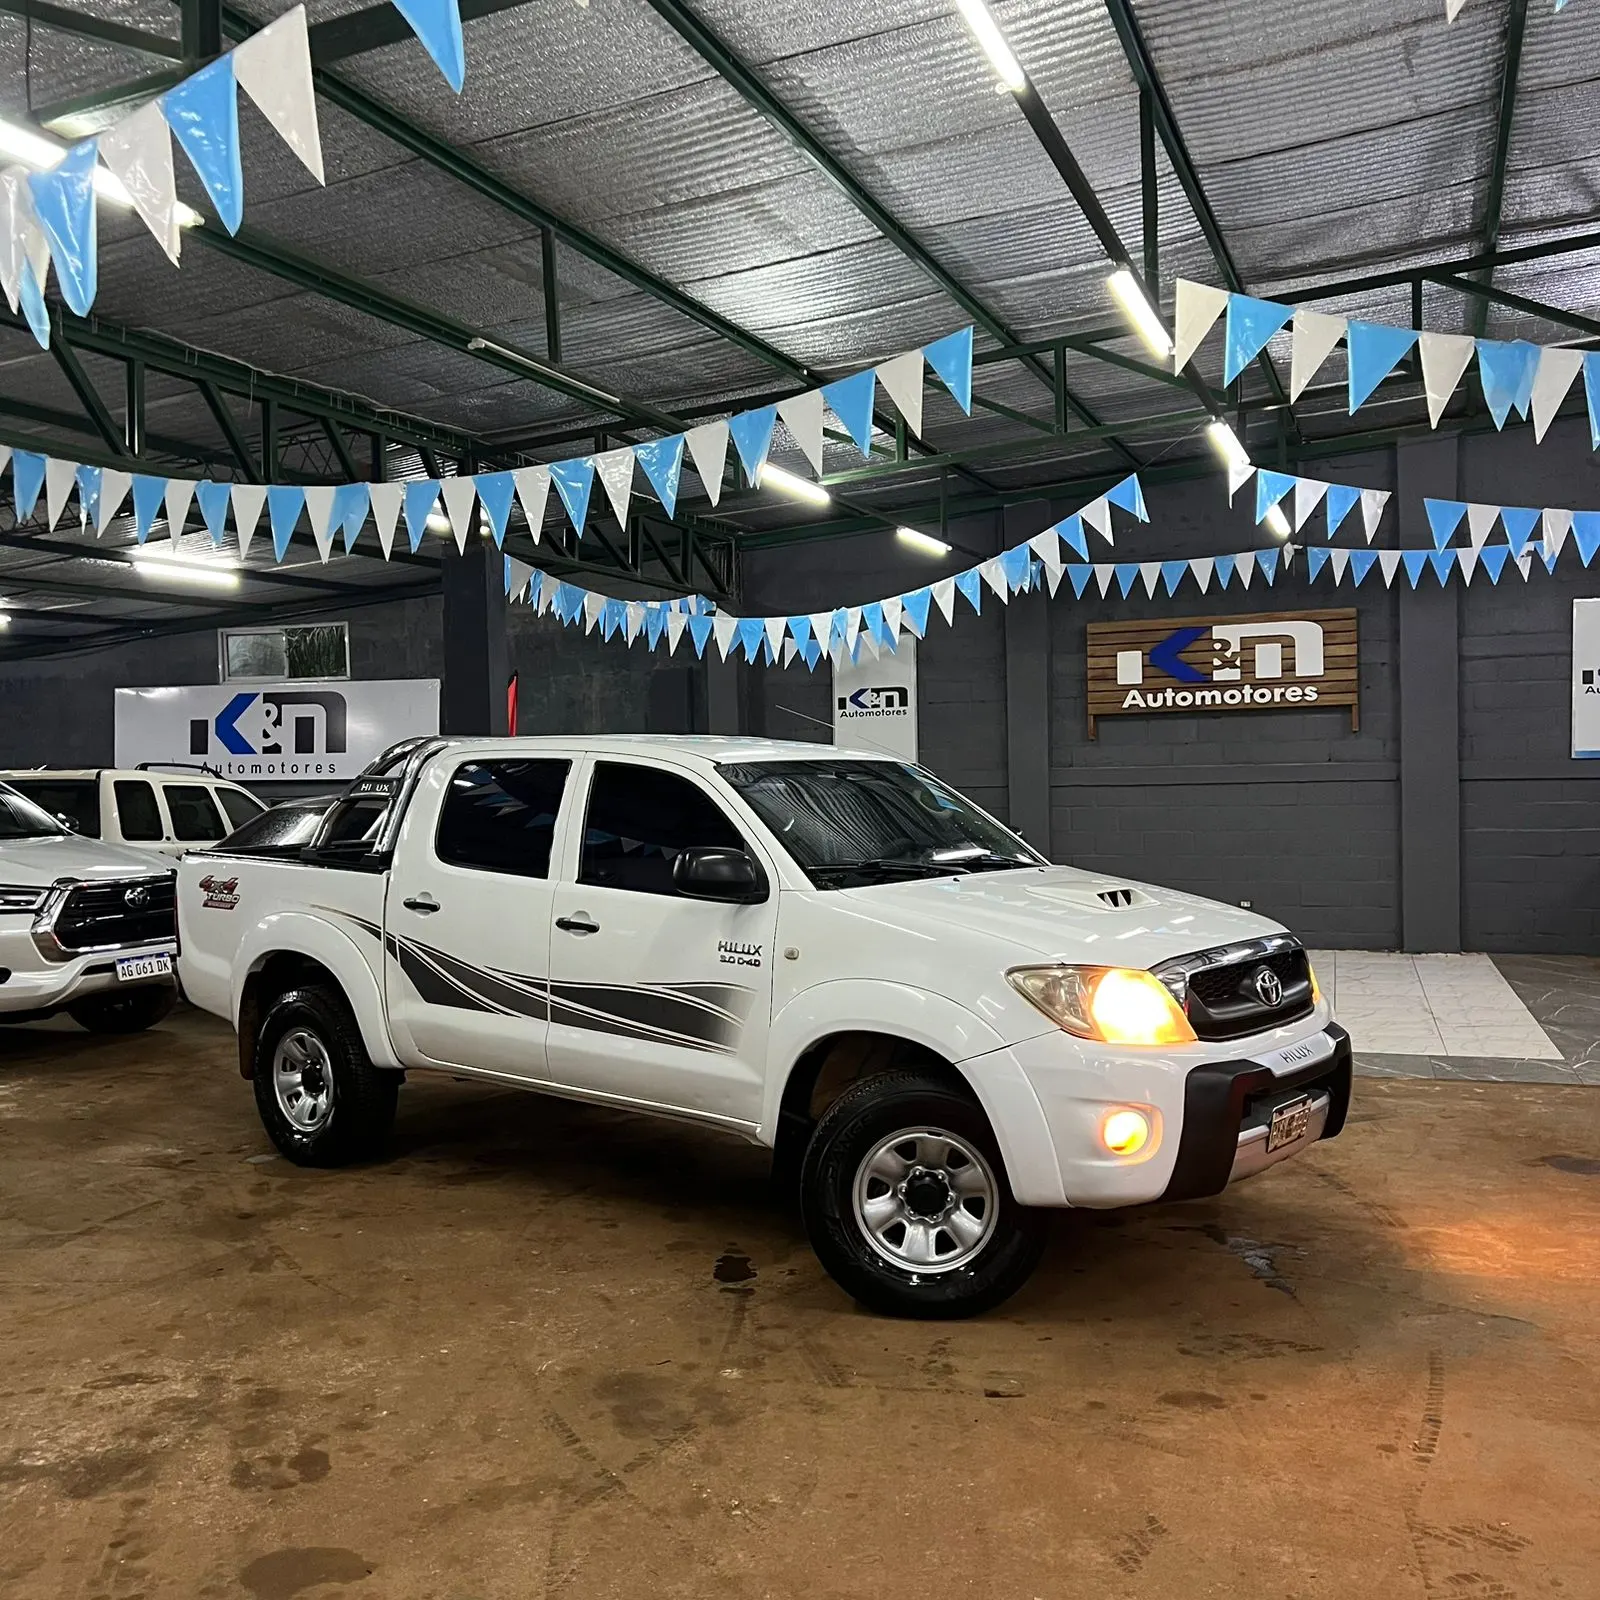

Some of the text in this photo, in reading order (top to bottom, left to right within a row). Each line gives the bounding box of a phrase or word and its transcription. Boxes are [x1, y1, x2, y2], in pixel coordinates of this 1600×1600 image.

[1121, 684, 1319, 709] Automotores
[840, 709, 907, 718] Automotores
[200, 761, 336, 774] Automotores
[207, 892, 240, 904] TURBO
[718, 940, 763, 957] HILUX
[121, 959, 170, 978] AG 061 DK
[1279, 1043, 1315, 1064] HILUX
